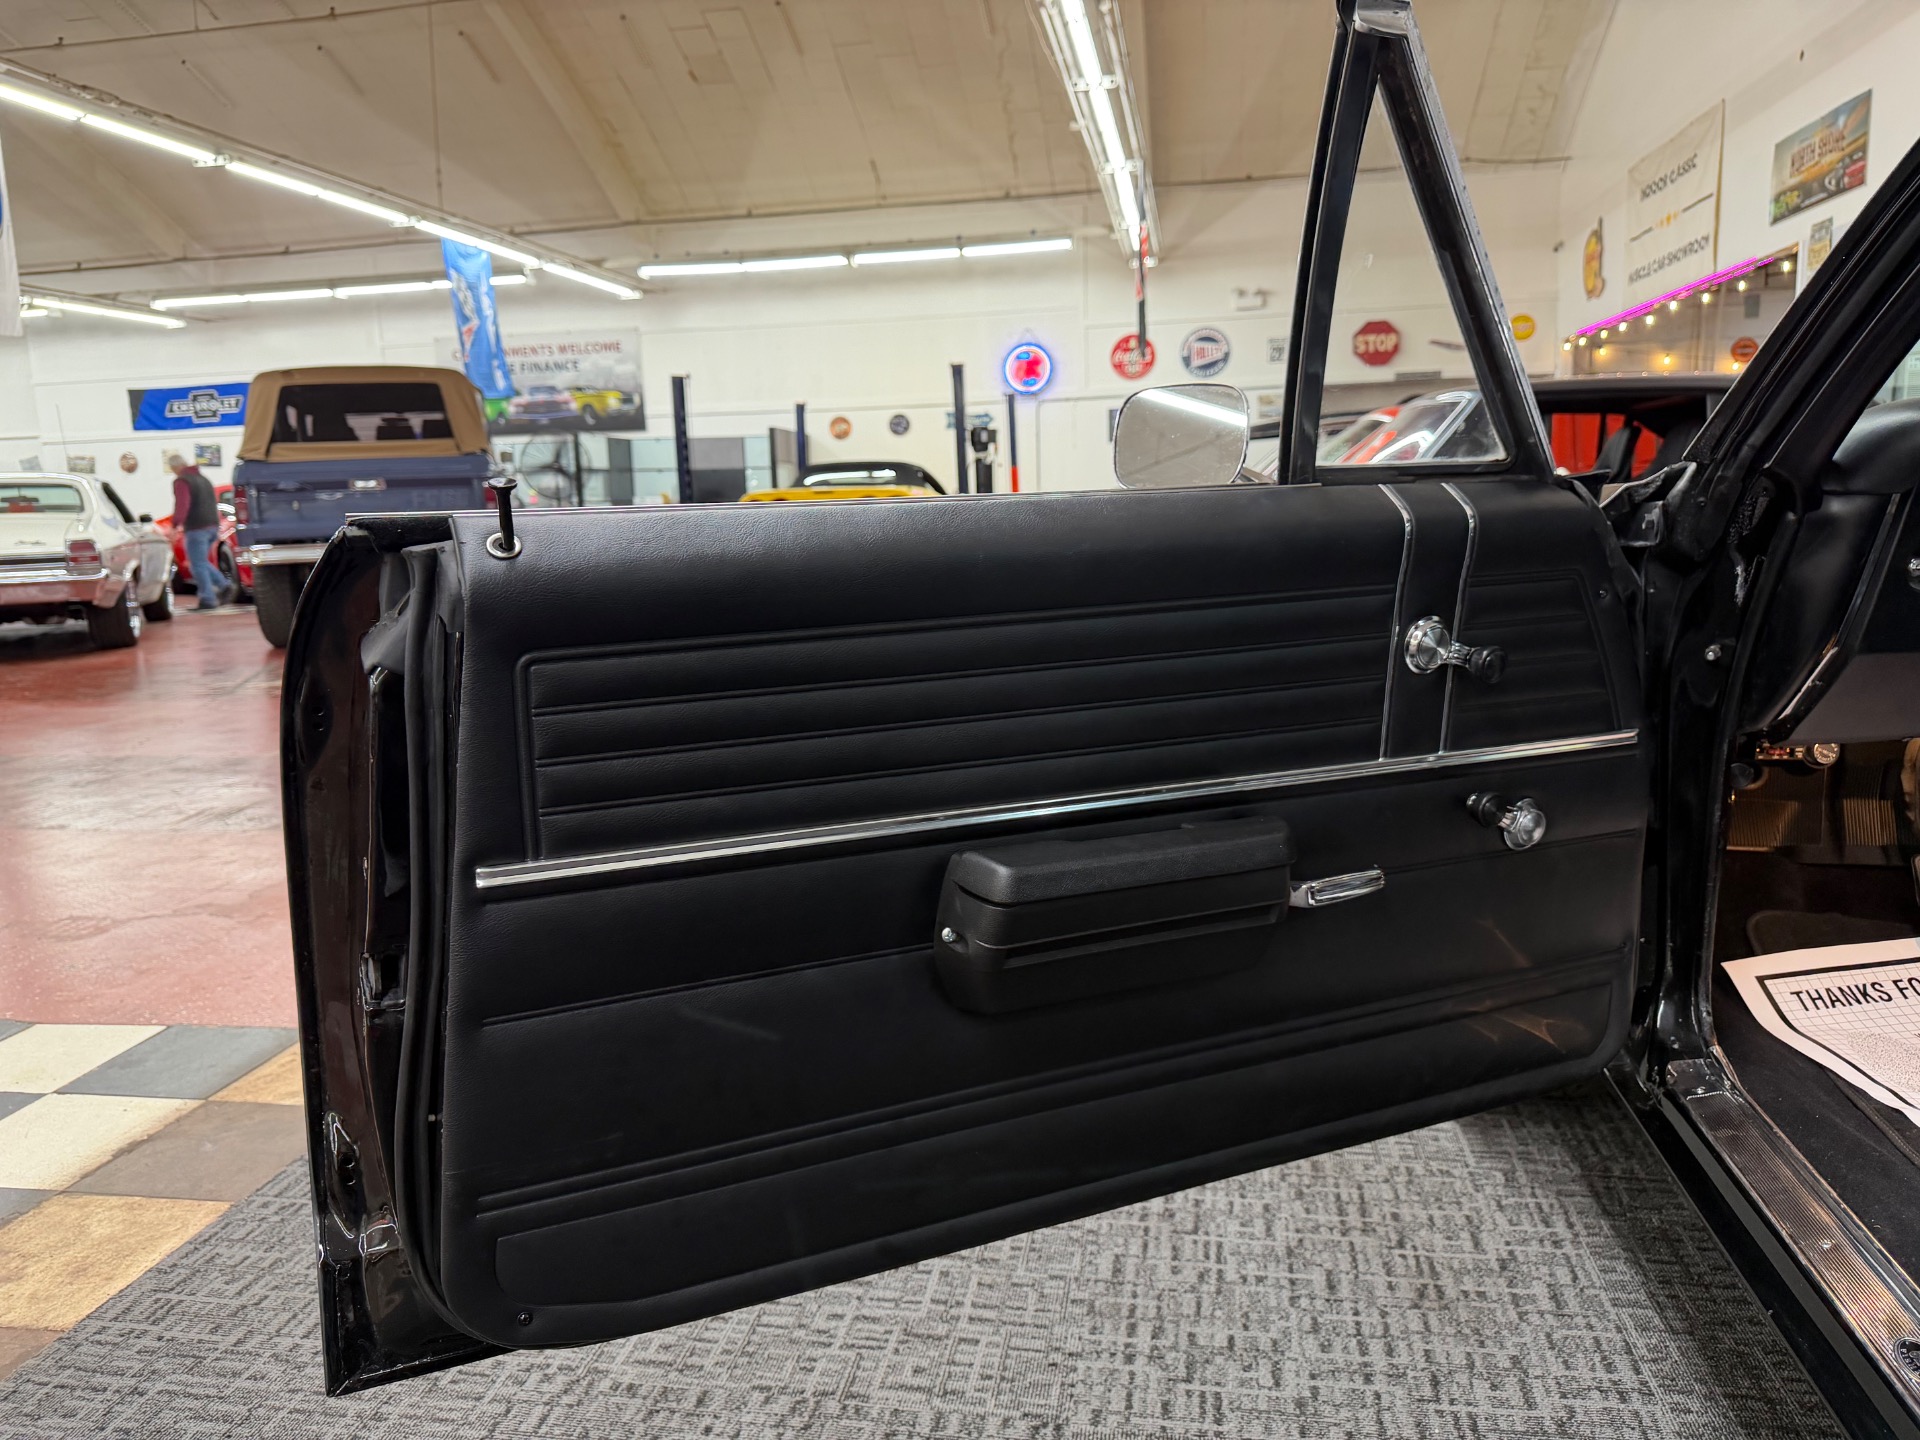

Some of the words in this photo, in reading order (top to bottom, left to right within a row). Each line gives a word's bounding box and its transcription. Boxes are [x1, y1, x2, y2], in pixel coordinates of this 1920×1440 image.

[557, 340, 622, 356] WELCOME
[1355, 332, 1398, 354] STOP
[520, 359, 580, 374] FINANCE
[171, 398, 238, 413] CHEVROLET
[1790, 982, 1893, 1012] THANKS
[1892, 977, 1920, 1000] FO
